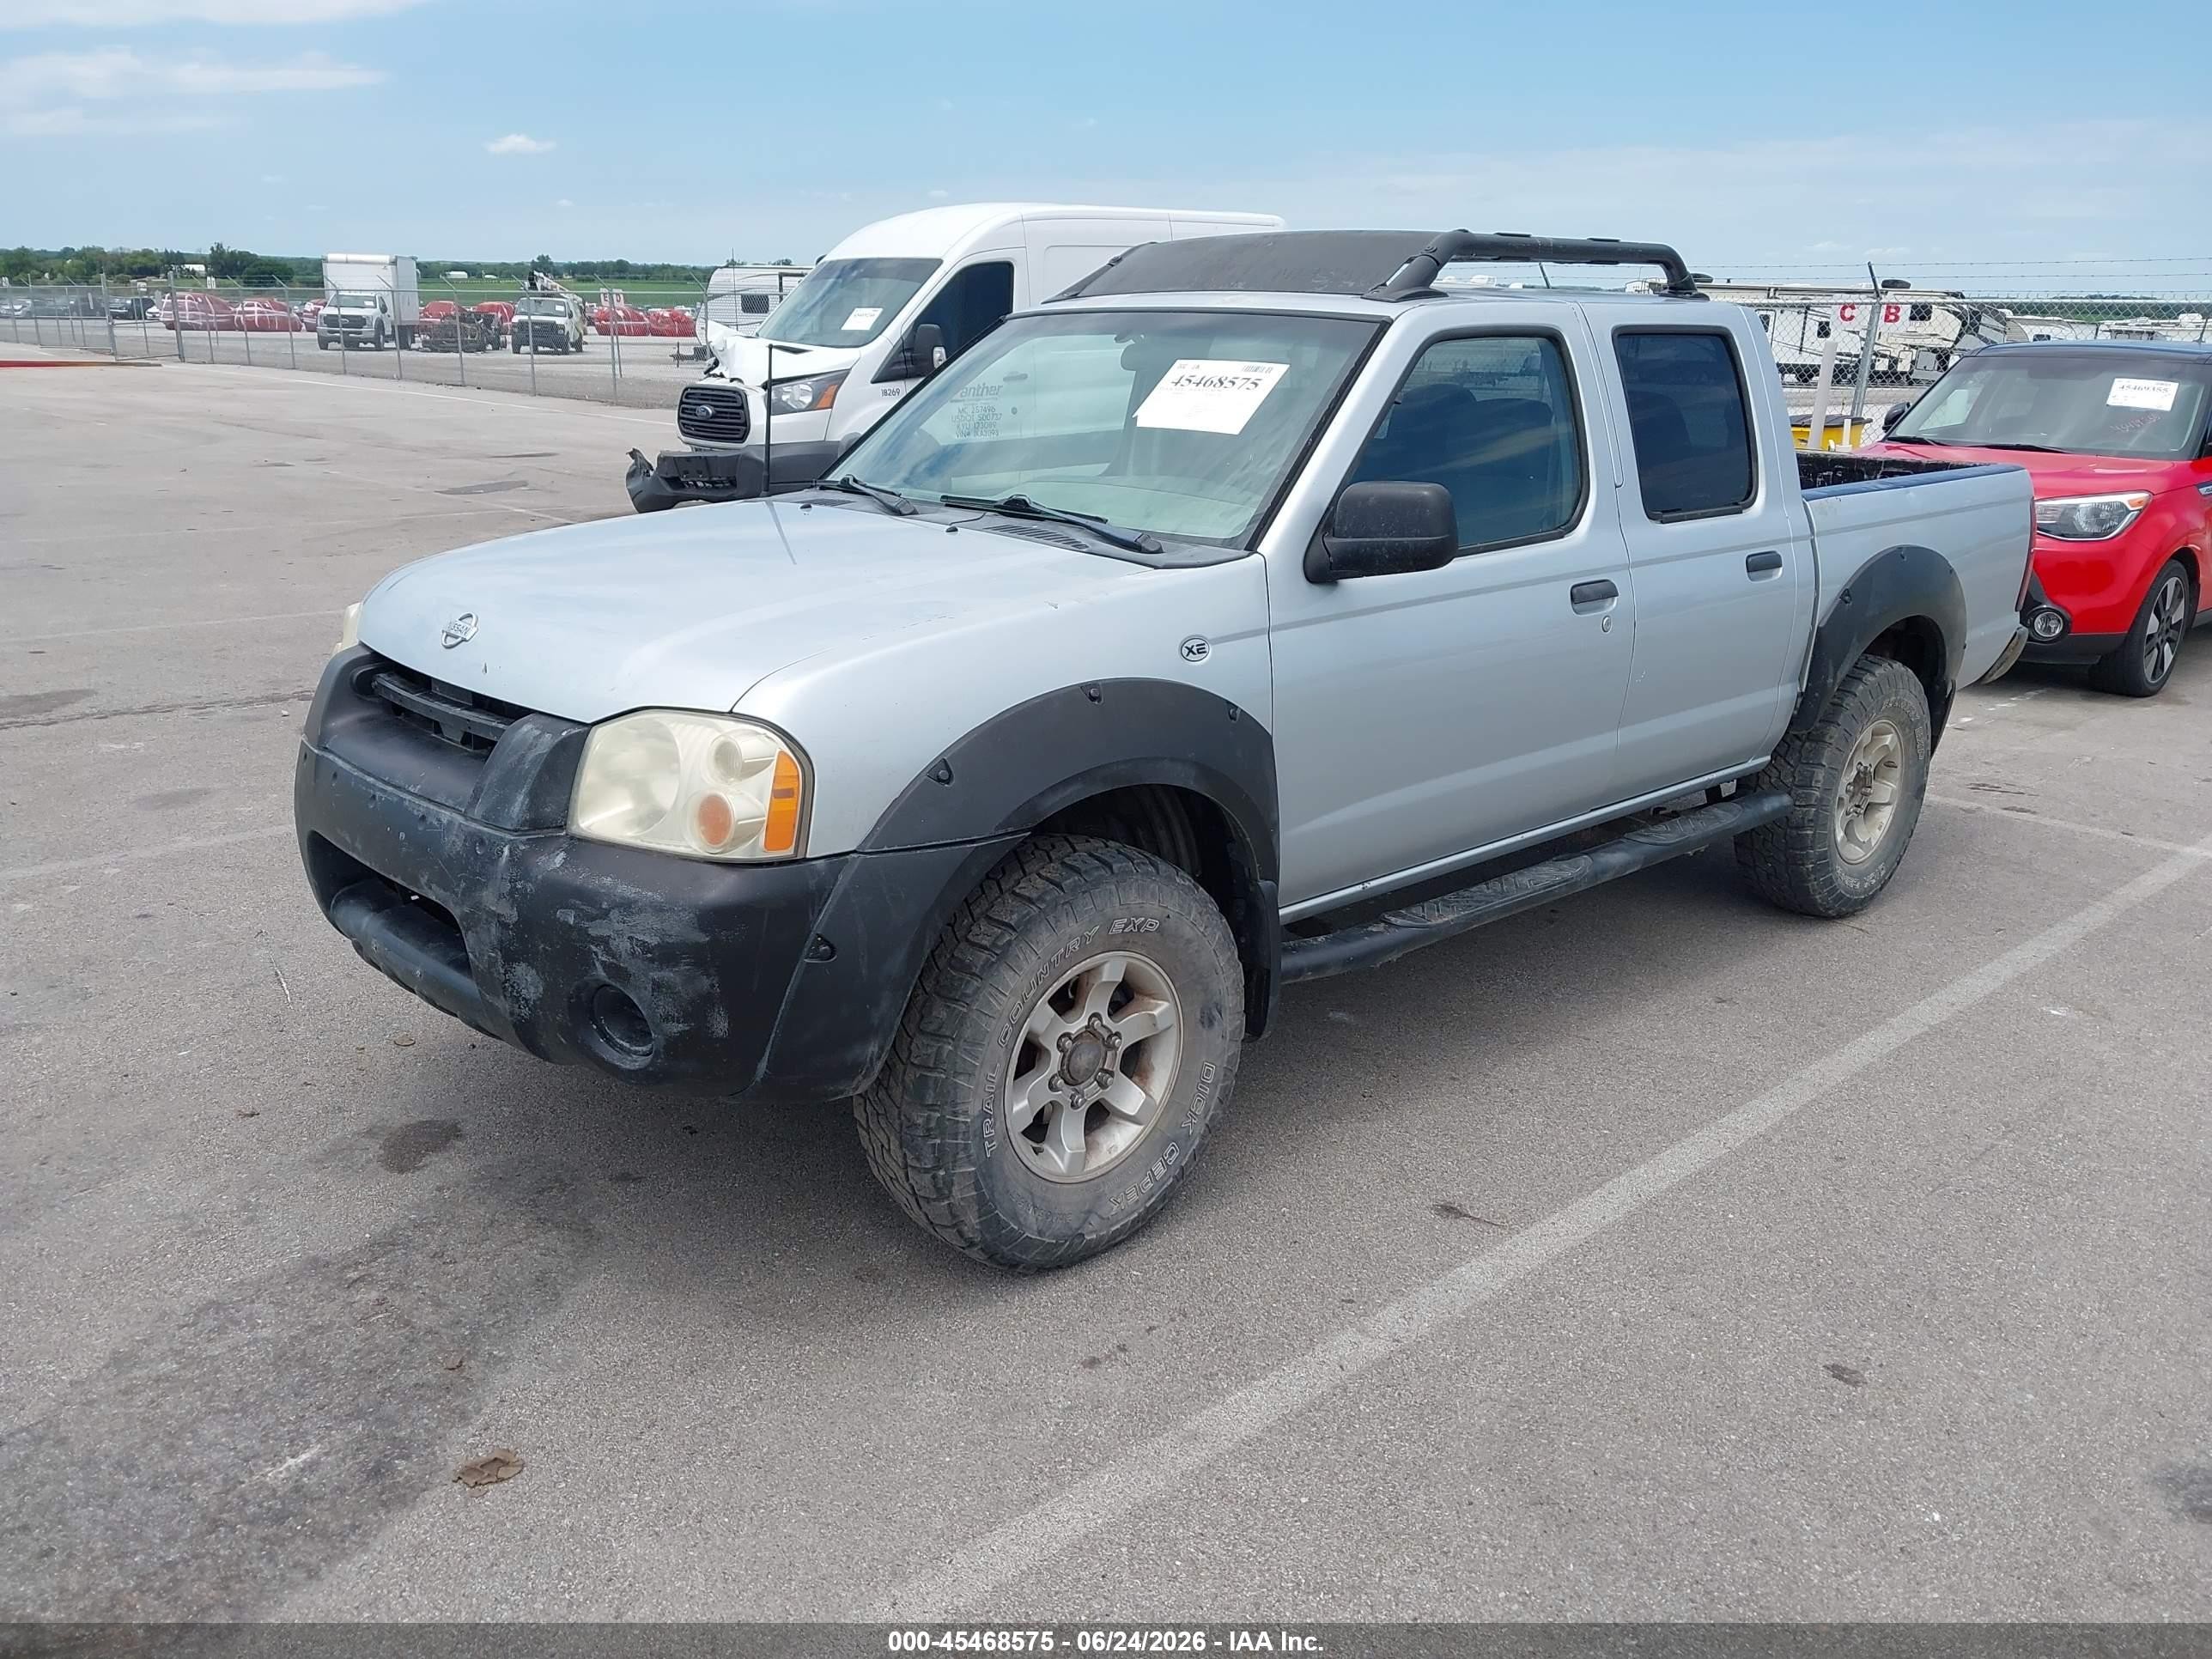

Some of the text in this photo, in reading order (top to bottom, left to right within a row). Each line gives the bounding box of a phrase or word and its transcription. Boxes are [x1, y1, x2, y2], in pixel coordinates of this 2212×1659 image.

[1840, 303, 1856, 322] C
[1884, 303, 1901, 323] B
[960, 383, 1003, 398] anther
[1171, 374, 1263, 391] 45468575
[881, 387, 901, 397] 18269
[1184, 642, 1207, 658] XE
[981, 916, 1160, 1158] TRAIL COUNTRY EXP
[1109, 1060, 1217, 1211] DICK CEPEK
